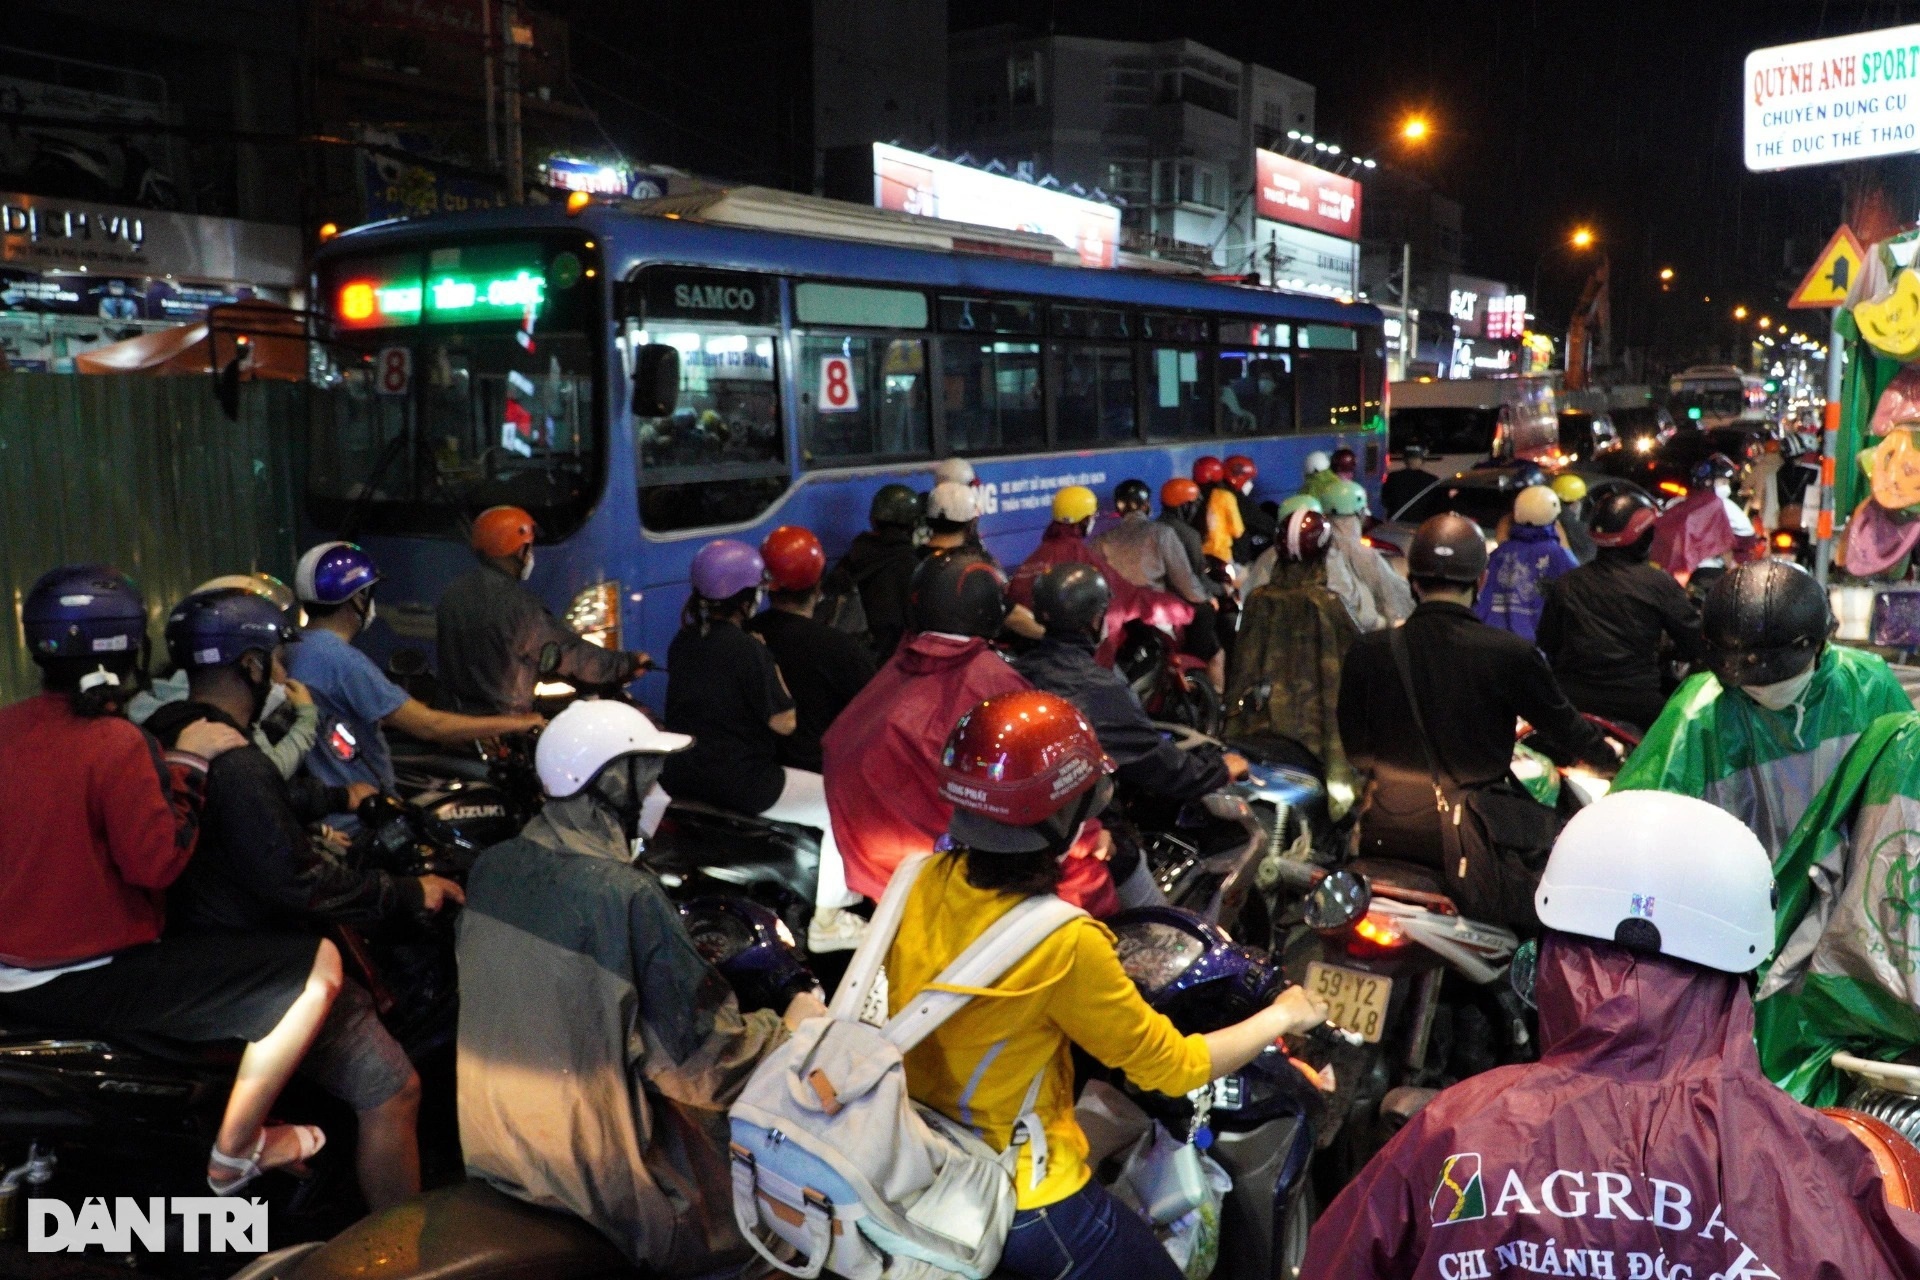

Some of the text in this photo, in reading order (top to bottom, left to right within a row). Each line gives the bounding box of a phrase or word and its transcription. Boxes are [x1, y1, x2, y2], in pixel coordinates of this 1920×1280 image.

[1754, 45, 1920, 107] QUỲNH ANH SPORT
[1763, 94, 1907, 127] CHUYÊN DỤNG CỤ
[1756, 121, 1915, 157] THỂ DỤC THỂ THAO
[2, 204, 146, 252] DỊCH VỤ
[674, 283, 756, 310] SAMCO
[384, 350, 406, 392] 8
[826, 360, 850, 406] 8
[438, 802, 506, 821] SUZUKI
[1438, 1249, 1492, 1280] CHI
[1494, 1237, 1617, 1280] NHÁNH
